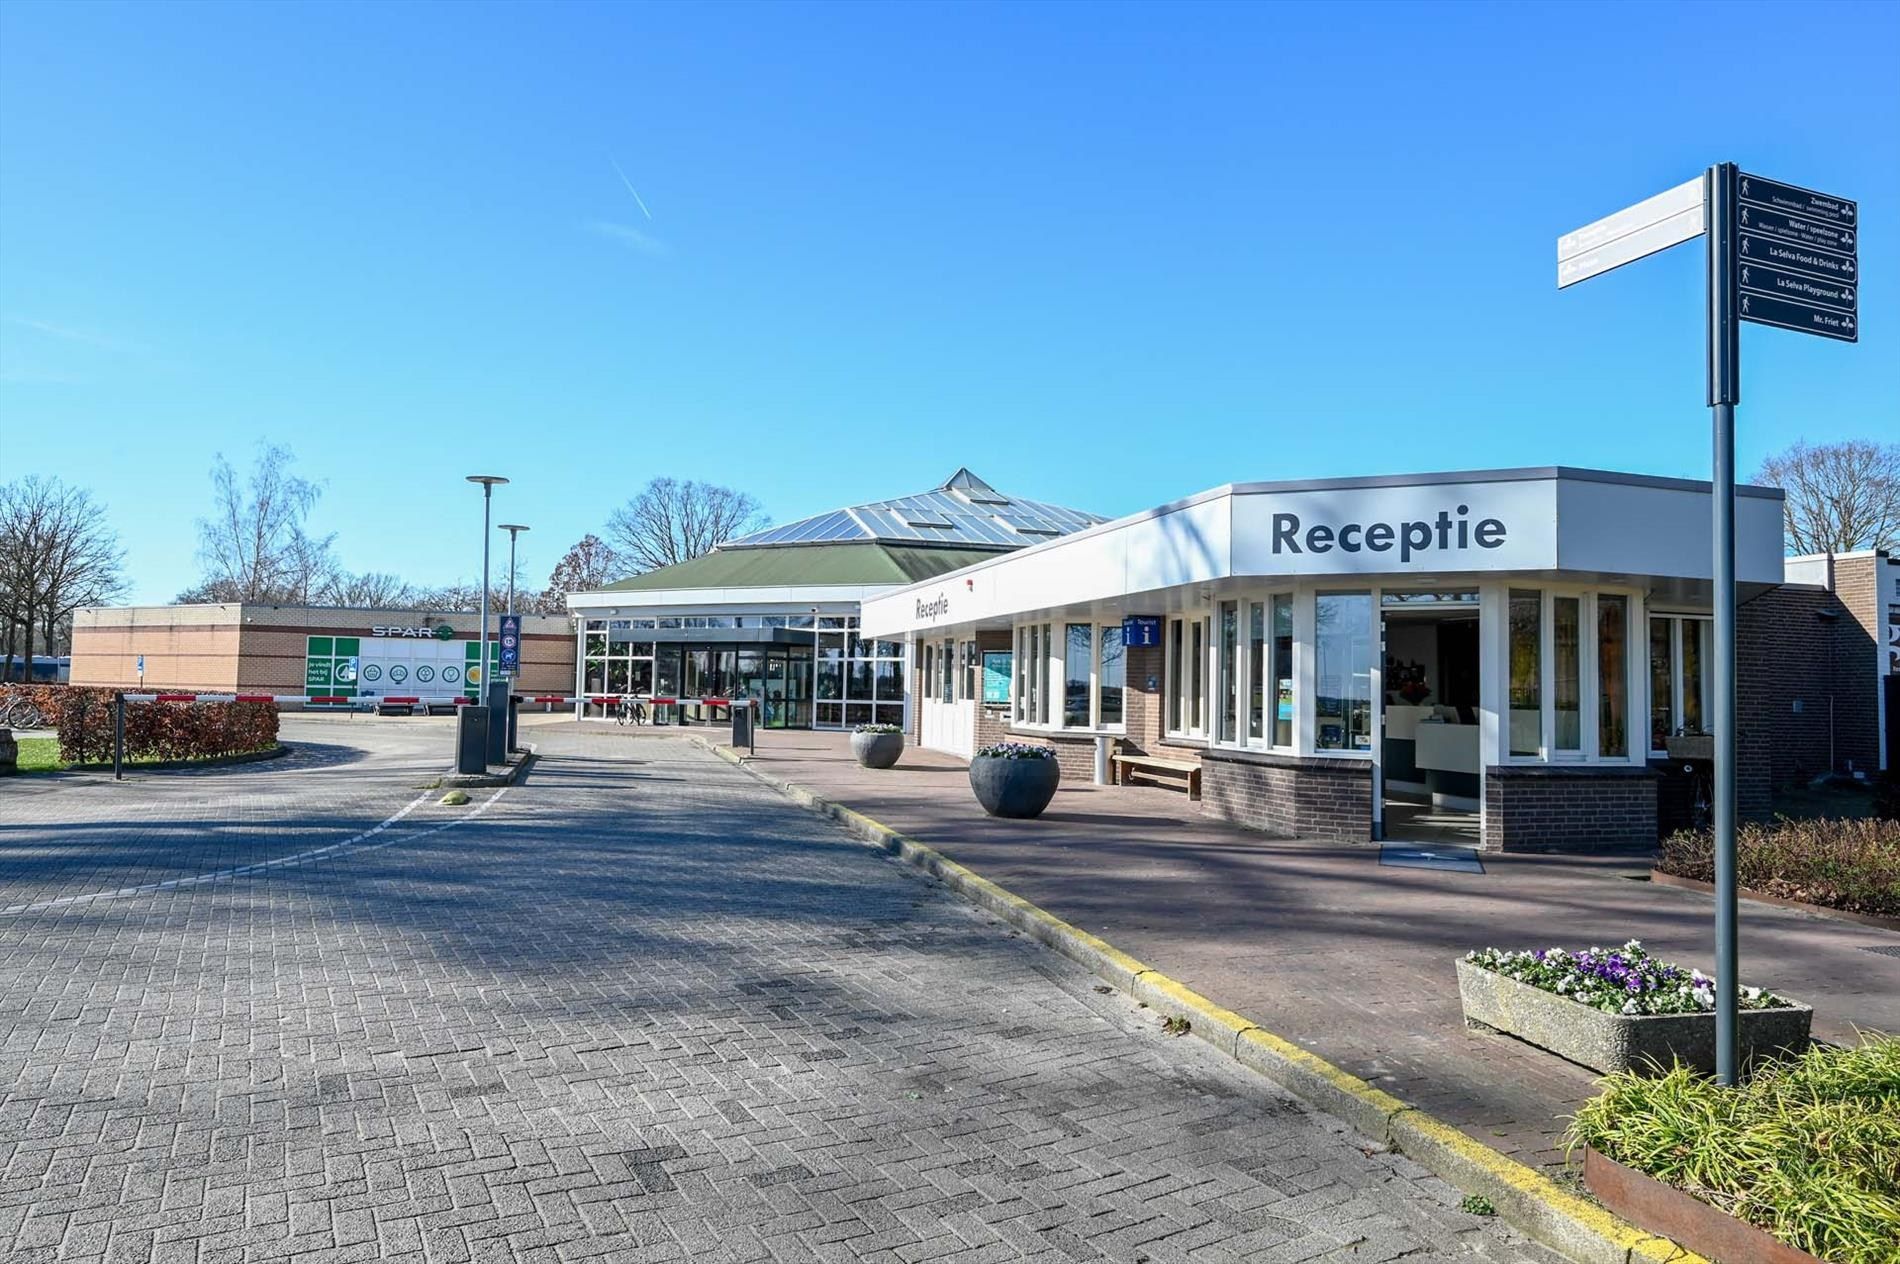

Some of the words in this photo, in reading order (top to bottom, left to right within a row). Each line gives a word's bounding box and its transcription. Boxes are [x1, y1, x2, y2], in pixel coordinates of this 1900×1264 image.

[1789, 220, 1806, 231] Water
[1810, 226, 1839, 238] speelzone
[1779, 249, 1796, 260] Selva
[1796, 253, 1812, 264] Food
[1819, 259, 1839, 270] Drinks
[1786, 280, 1802, 291] Selva
[1803, 284, 1839, 299] Playground
[1825, 316, 1839, 327] Friet
[1271, 504, 1508, 563] Receptie
[915, 591, 949, 623] Receptie
[372, 625, 433, 639] SPAR
